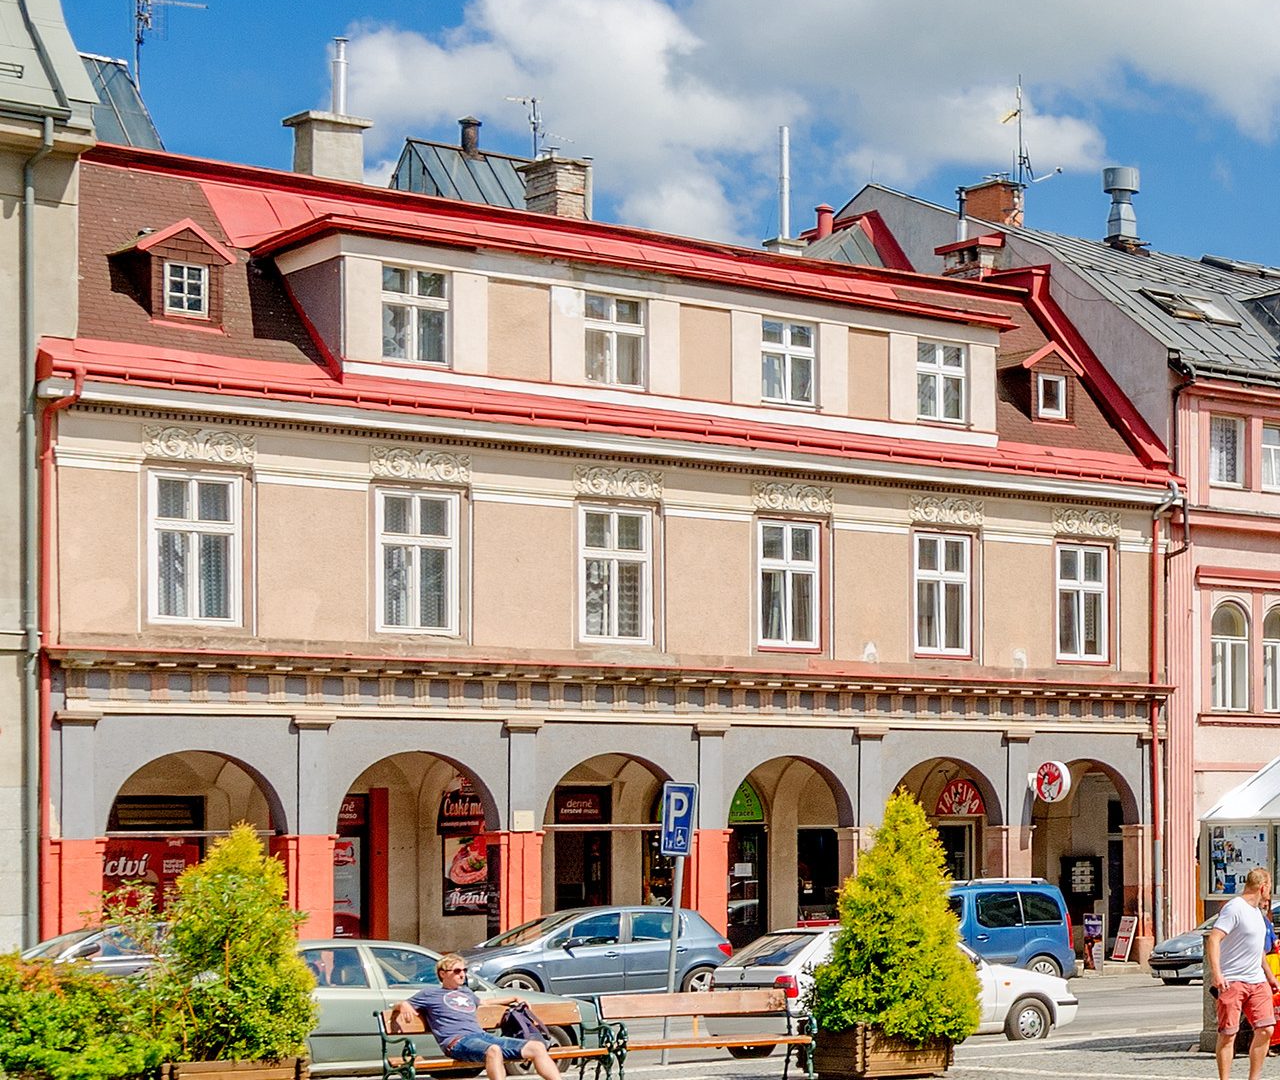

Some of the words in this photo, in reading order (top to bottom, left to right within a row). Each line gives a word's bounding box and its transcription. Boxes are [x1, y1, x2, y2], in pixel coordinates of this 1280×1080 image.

[444, 792, 469, 816] České
[566, 799, 593, 808] denně
[668, 792, 689, 832] P
